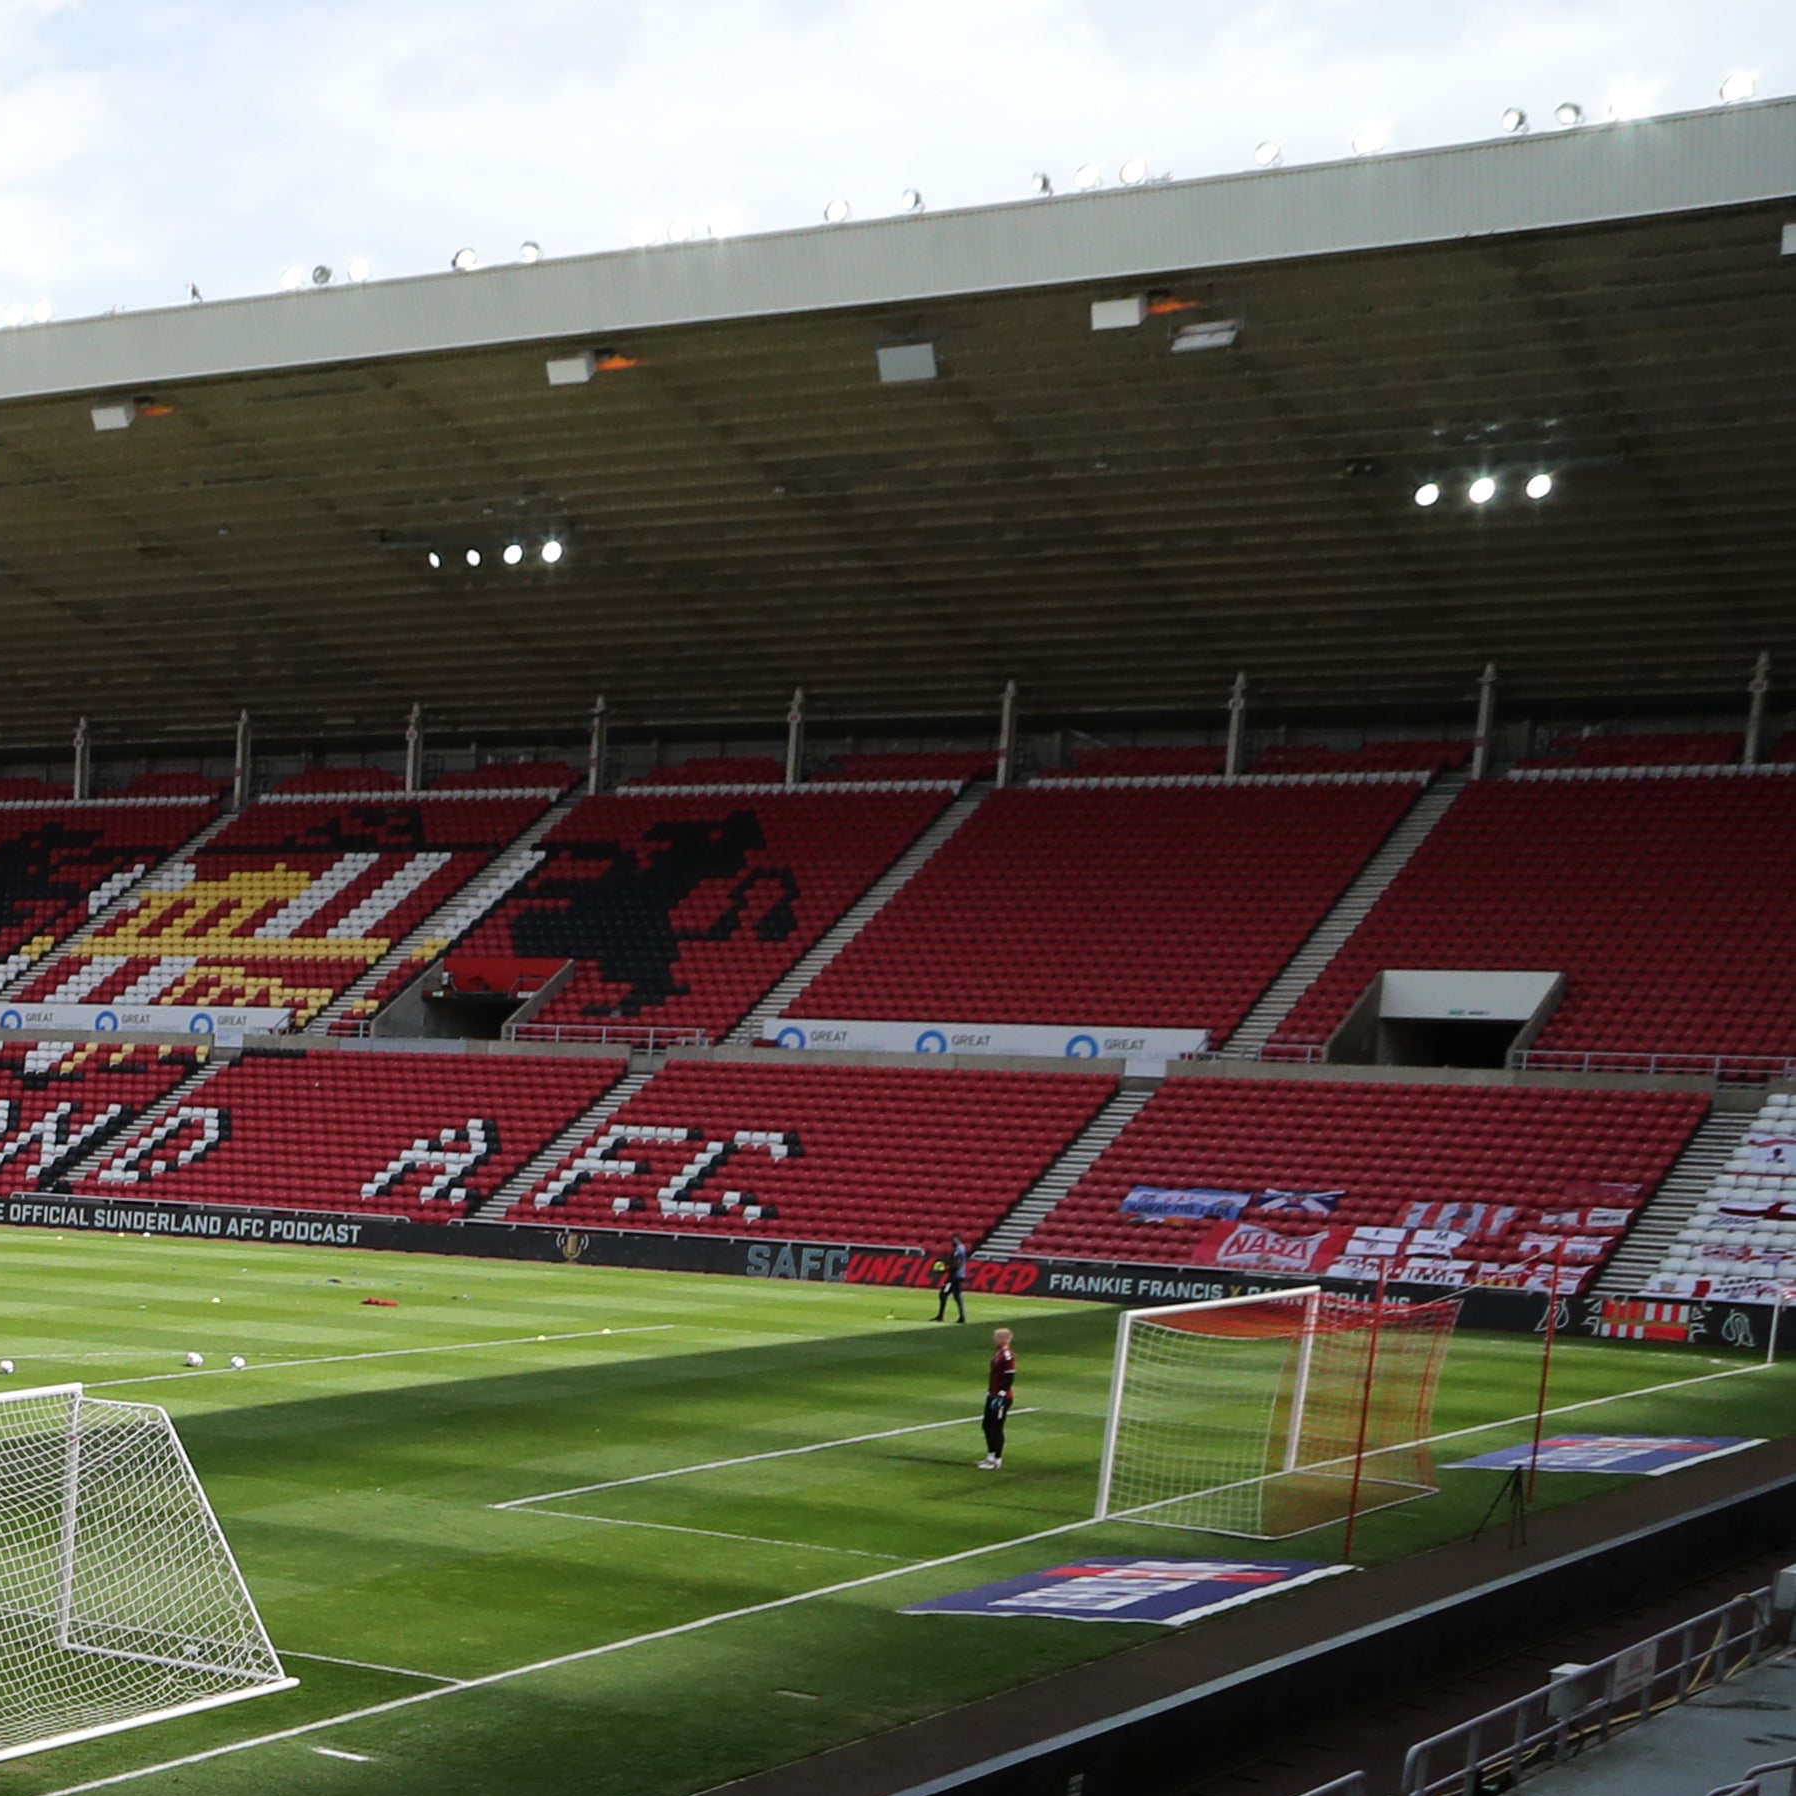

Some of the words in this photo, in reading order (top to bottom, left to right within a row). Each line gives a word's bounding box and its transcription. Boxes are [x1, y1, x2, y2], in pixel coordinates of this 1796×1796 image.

[25, 1012, 54, 1023] GREAT
[121, 1014, 150, 1024] GREAT
[217, 1015, 248, 1026] GREAT
[810, 1030, 847, 1043] GREAT
[951, 1035, 991, 1047] GREAT
[1104, 1038, 1145, 1051] GREAT
[10, 1203, 89, 1226] OFFICIAL
[94, 1208, 222, 1234] SUNDERLAND
[225, 1217, 264, 1238] AFC
[269, 1221, 362, 1244] PODCAST
[746, 1245, 848, 1283] SAFC
[1049, 1273, 1133, 1296] FRANKIE
[1137, 1278, 1224, 1300] FRANCIS
